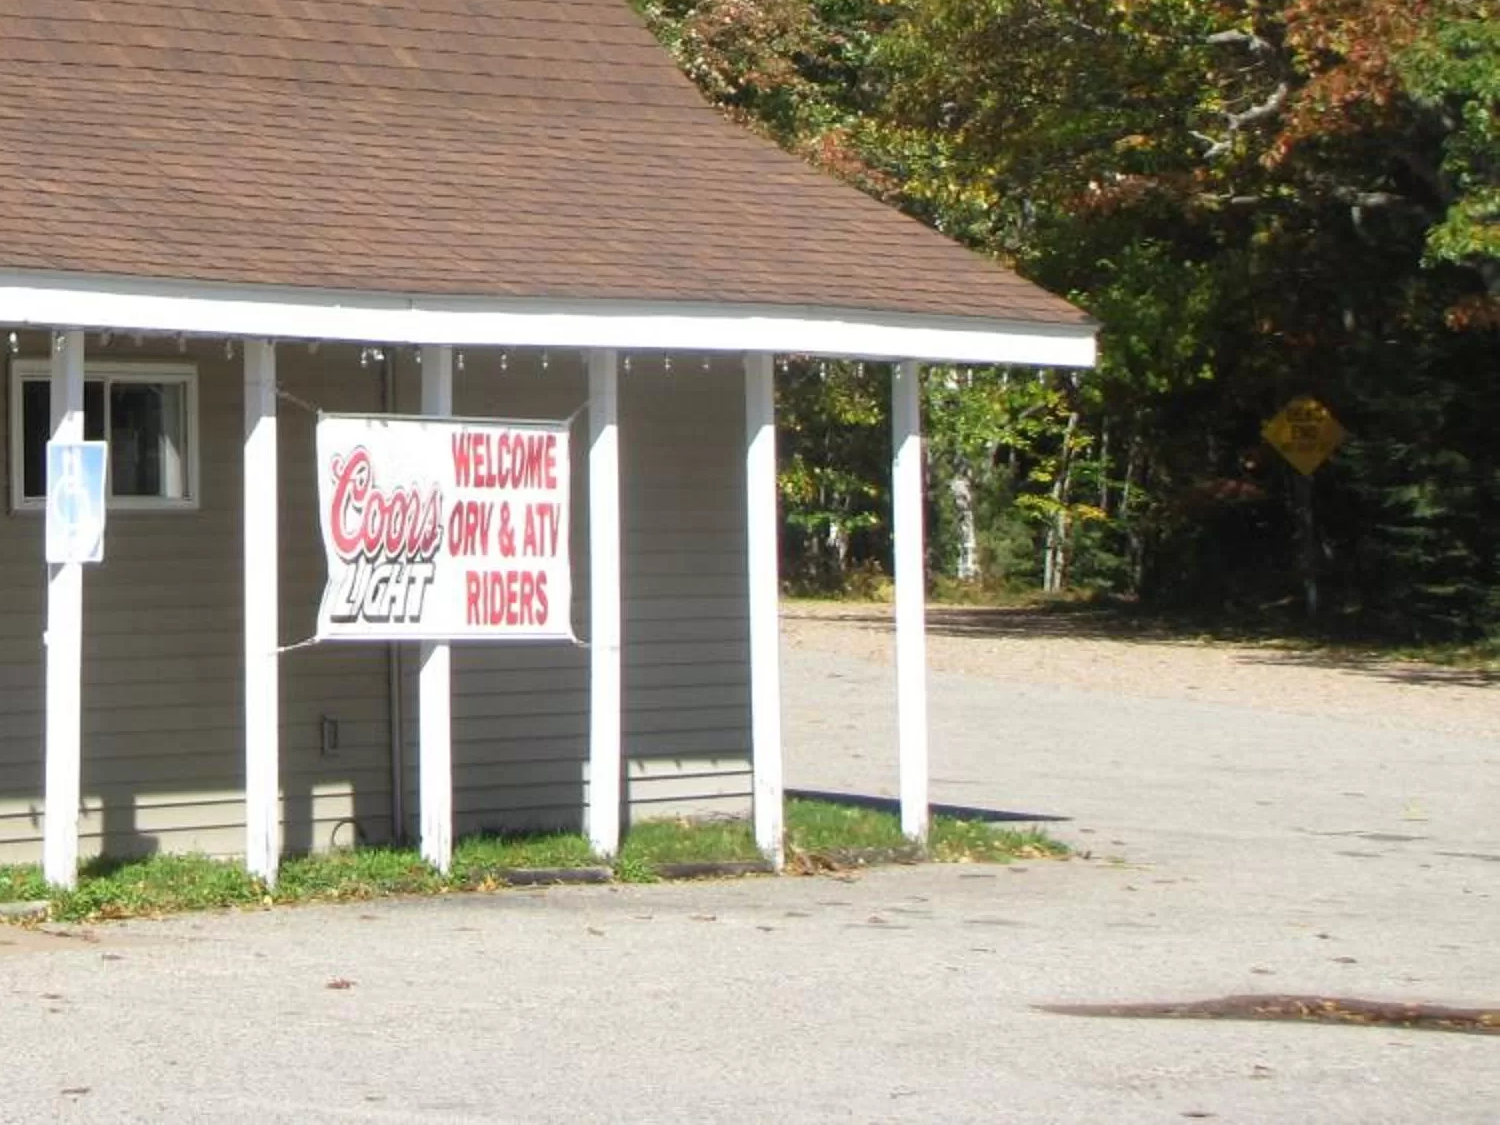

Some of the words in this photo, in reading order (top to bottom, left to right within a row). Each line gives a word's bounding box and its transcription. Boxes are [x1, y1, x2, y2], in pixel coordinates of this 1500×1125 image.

[451, 432, 557, 490] WELCOME
[330, 443, 443, 563] Coors
[448, 501, 494, 557] ORV
[498, 501, 515, 558] &
[523, 503, 560, 558] ATV
[330, 561, 436, 624] LIGHT
[466, 570, 549, 626] RIDERS
